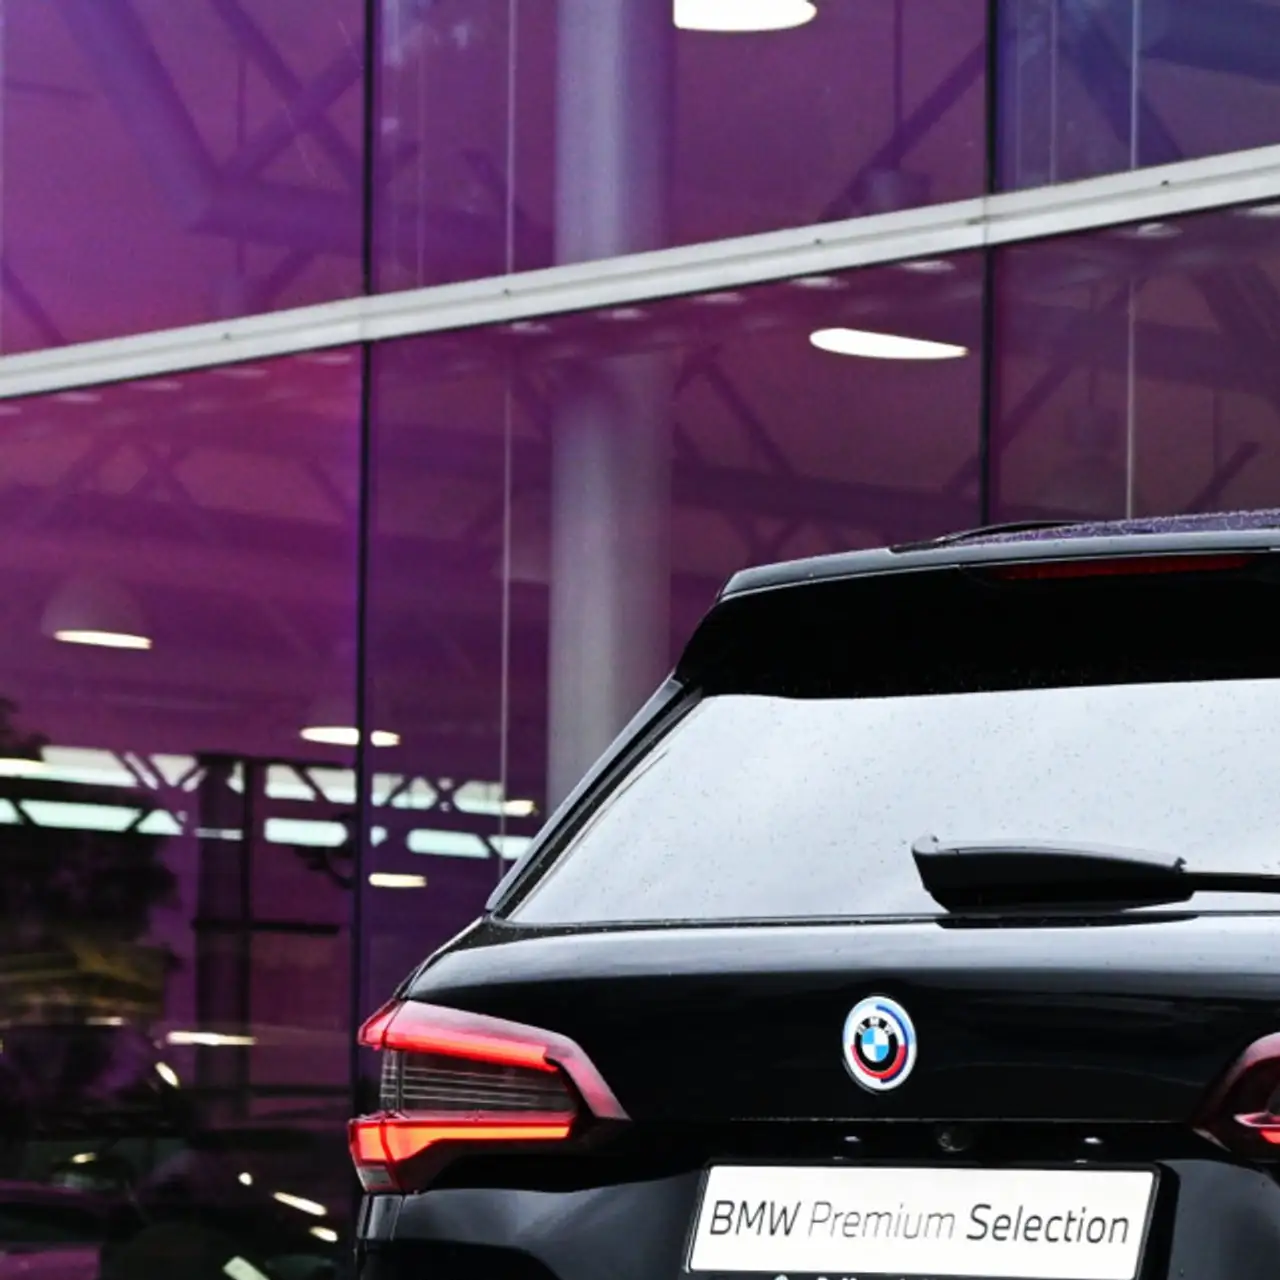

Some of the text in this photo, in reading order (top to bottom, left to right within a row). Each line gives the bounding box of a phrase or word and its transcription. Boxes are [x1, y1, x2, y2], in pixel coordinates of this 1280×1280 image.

[709, 1199, 1129, 1244] BMW Premium Selection
